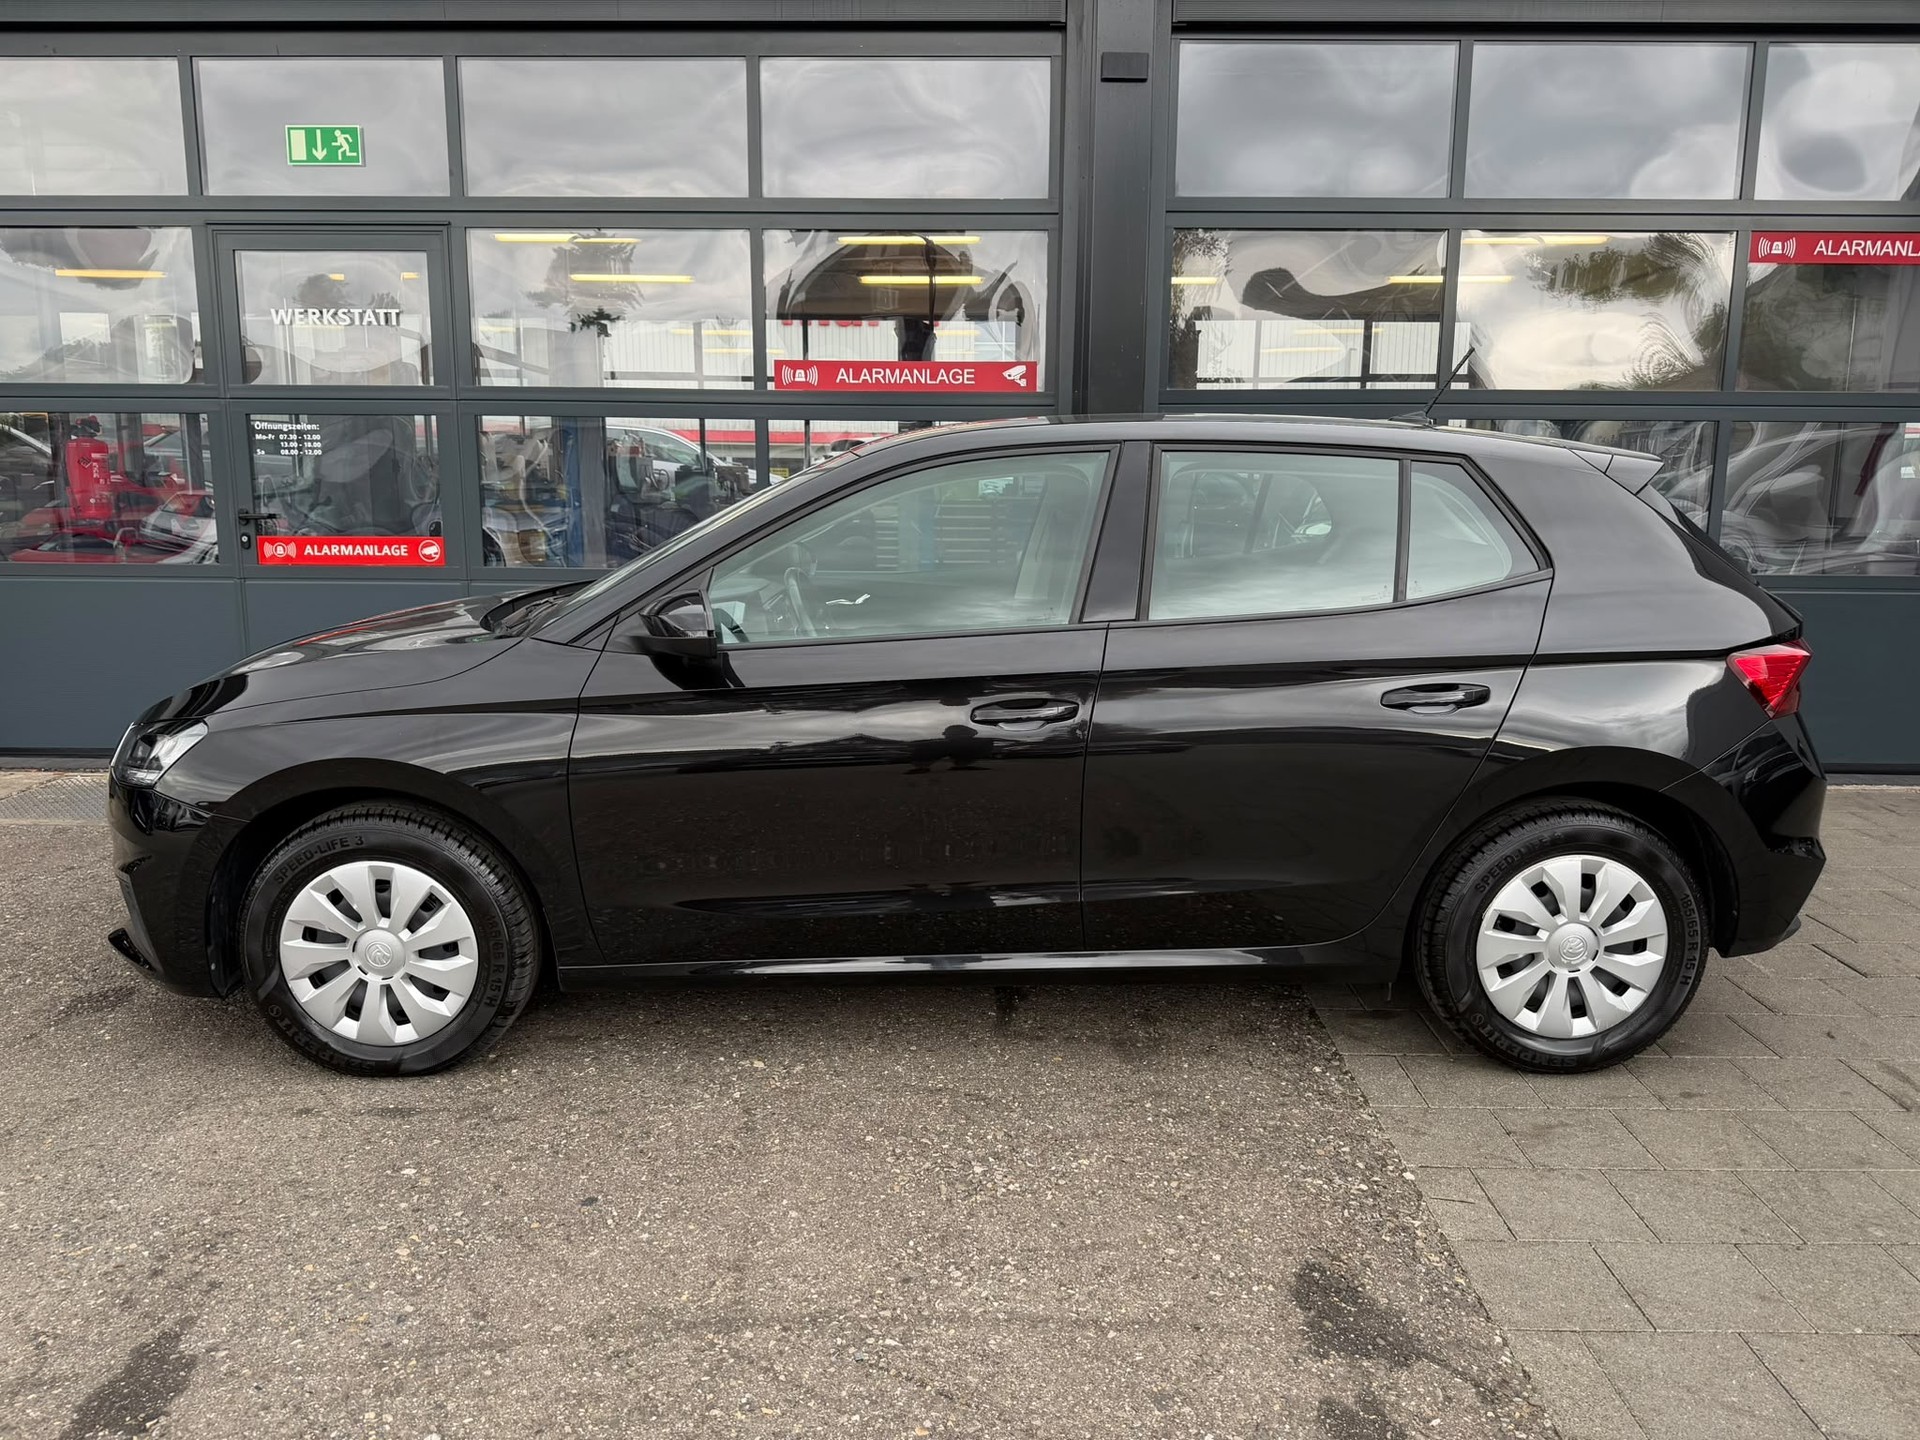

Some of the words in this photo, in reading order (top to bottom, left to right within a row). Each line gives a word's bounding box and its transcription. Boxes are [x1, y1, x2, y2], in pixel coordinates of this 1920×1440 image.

[270, 308, 400, 326] WERKSTATT
[835, 367, 976, 385] ALARMANLAGE
[303, 544, 409, 556] ALARMANLAGE
[273, 836, 350, 884] SPEED-LIFE
[354, 834, 365, 846] 3
[1680, 893, 1698, 938] 185/65
[1688, 942, 1698, 951] R
[493, 963, 505, 974] R
[1684, 957, 1697, 970] 15
[489, 979, 503, 992] 15
[1680, 975, 1691, 985] H
[484, 996, 498, 1008] H
[1478, 1023, 1578, 1067] SEMPERIT
